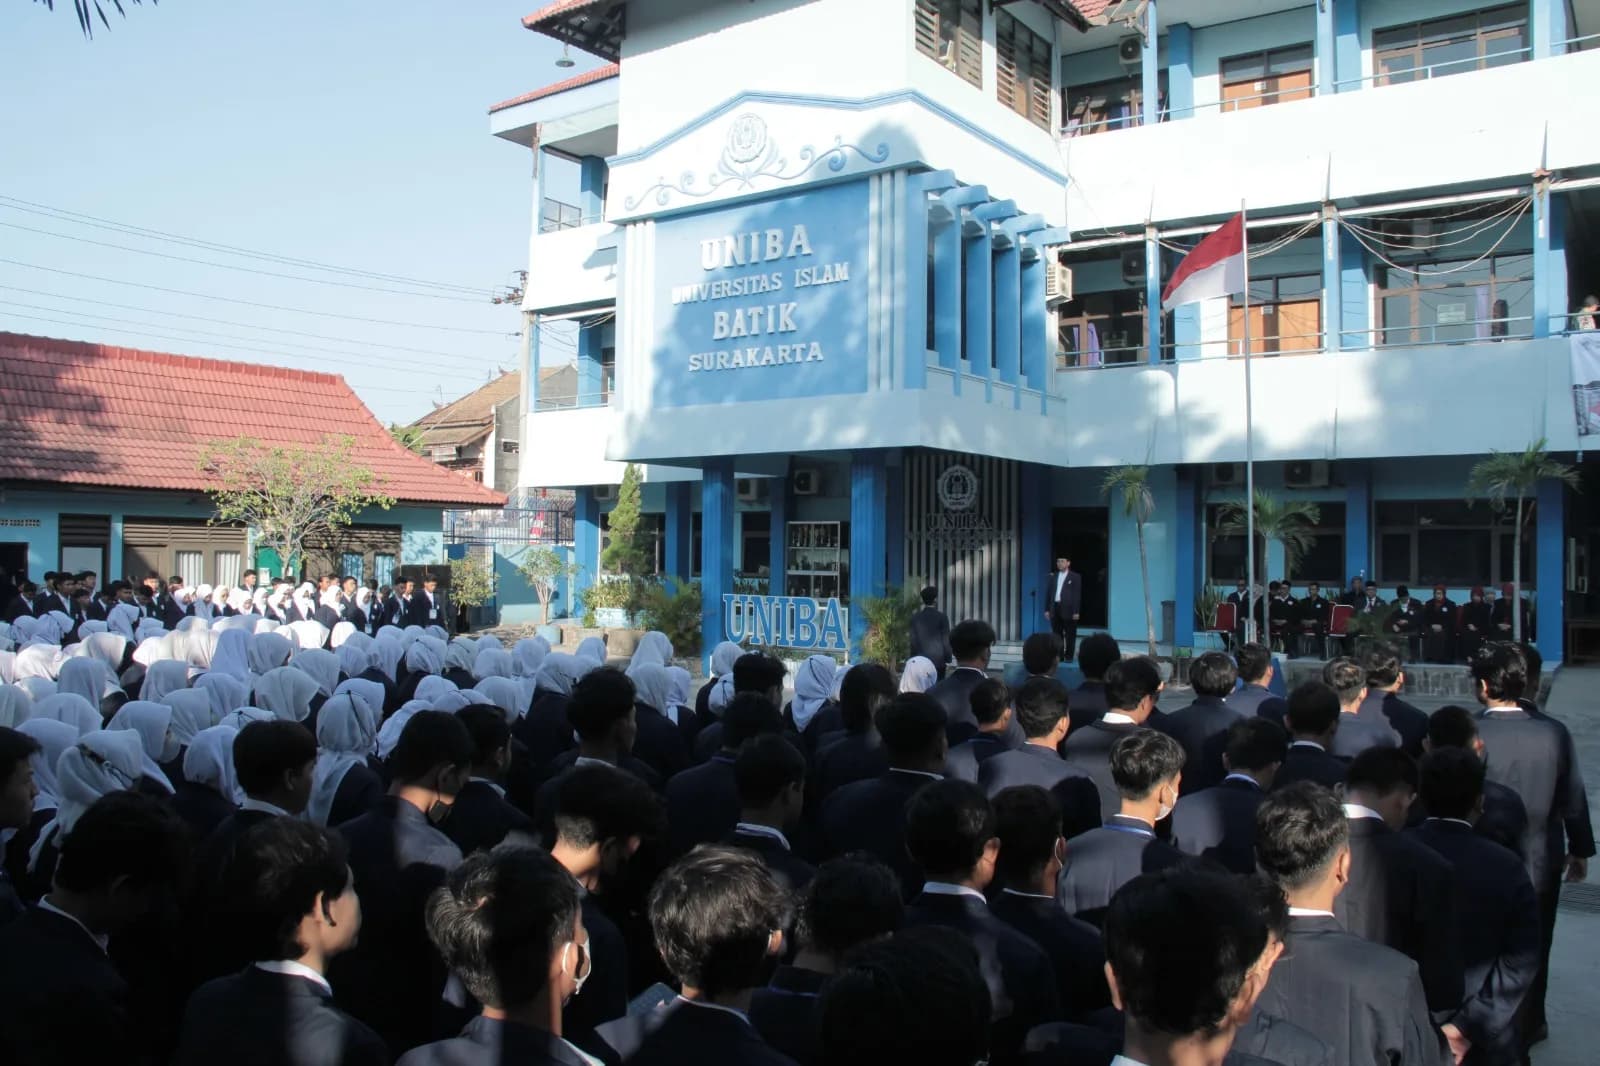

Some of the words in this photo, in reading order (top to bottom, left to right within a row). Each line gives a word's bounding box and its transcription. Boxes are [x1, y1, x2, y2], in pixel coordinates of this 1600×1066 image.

[700, 224, 813, 271] UNIBA
[672, 272, 782, 304] UNIVERSITAS
[795, 262, 849, 288] ISLAM
[713, 302, 797, 340] BATIK
[689, 341, 824, 371] SURAKARTA
[723, 594, 848, 649] UNIBA
